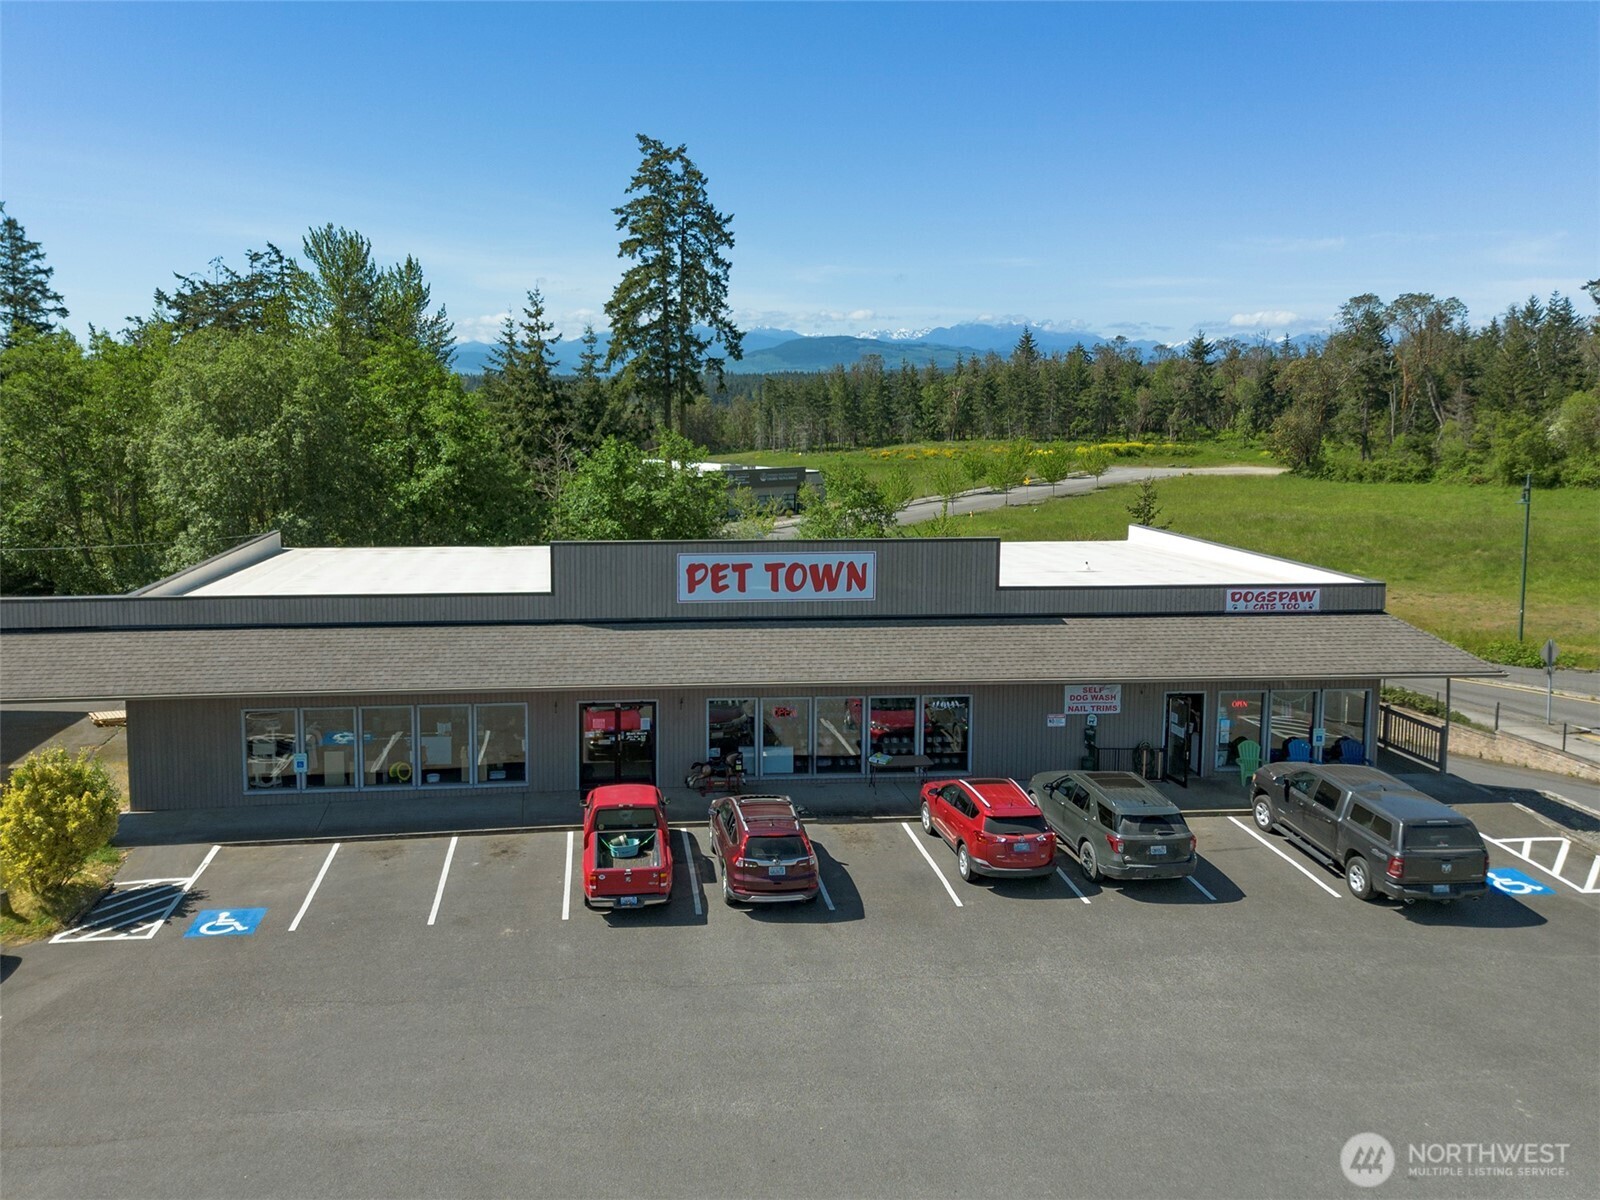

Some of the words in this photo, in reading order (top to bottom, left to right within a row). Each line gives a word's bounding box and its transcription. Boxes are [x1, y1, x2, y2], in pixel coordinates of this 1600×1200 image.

[686, 562, 753, 594] PET
[764, 560, 868, 593] TOWN
[1230, 590, 1316, 602] DOGSPAW
[1253, 602, 1276, 610] CATS
[1281, 602, 1300, 610] TOO
